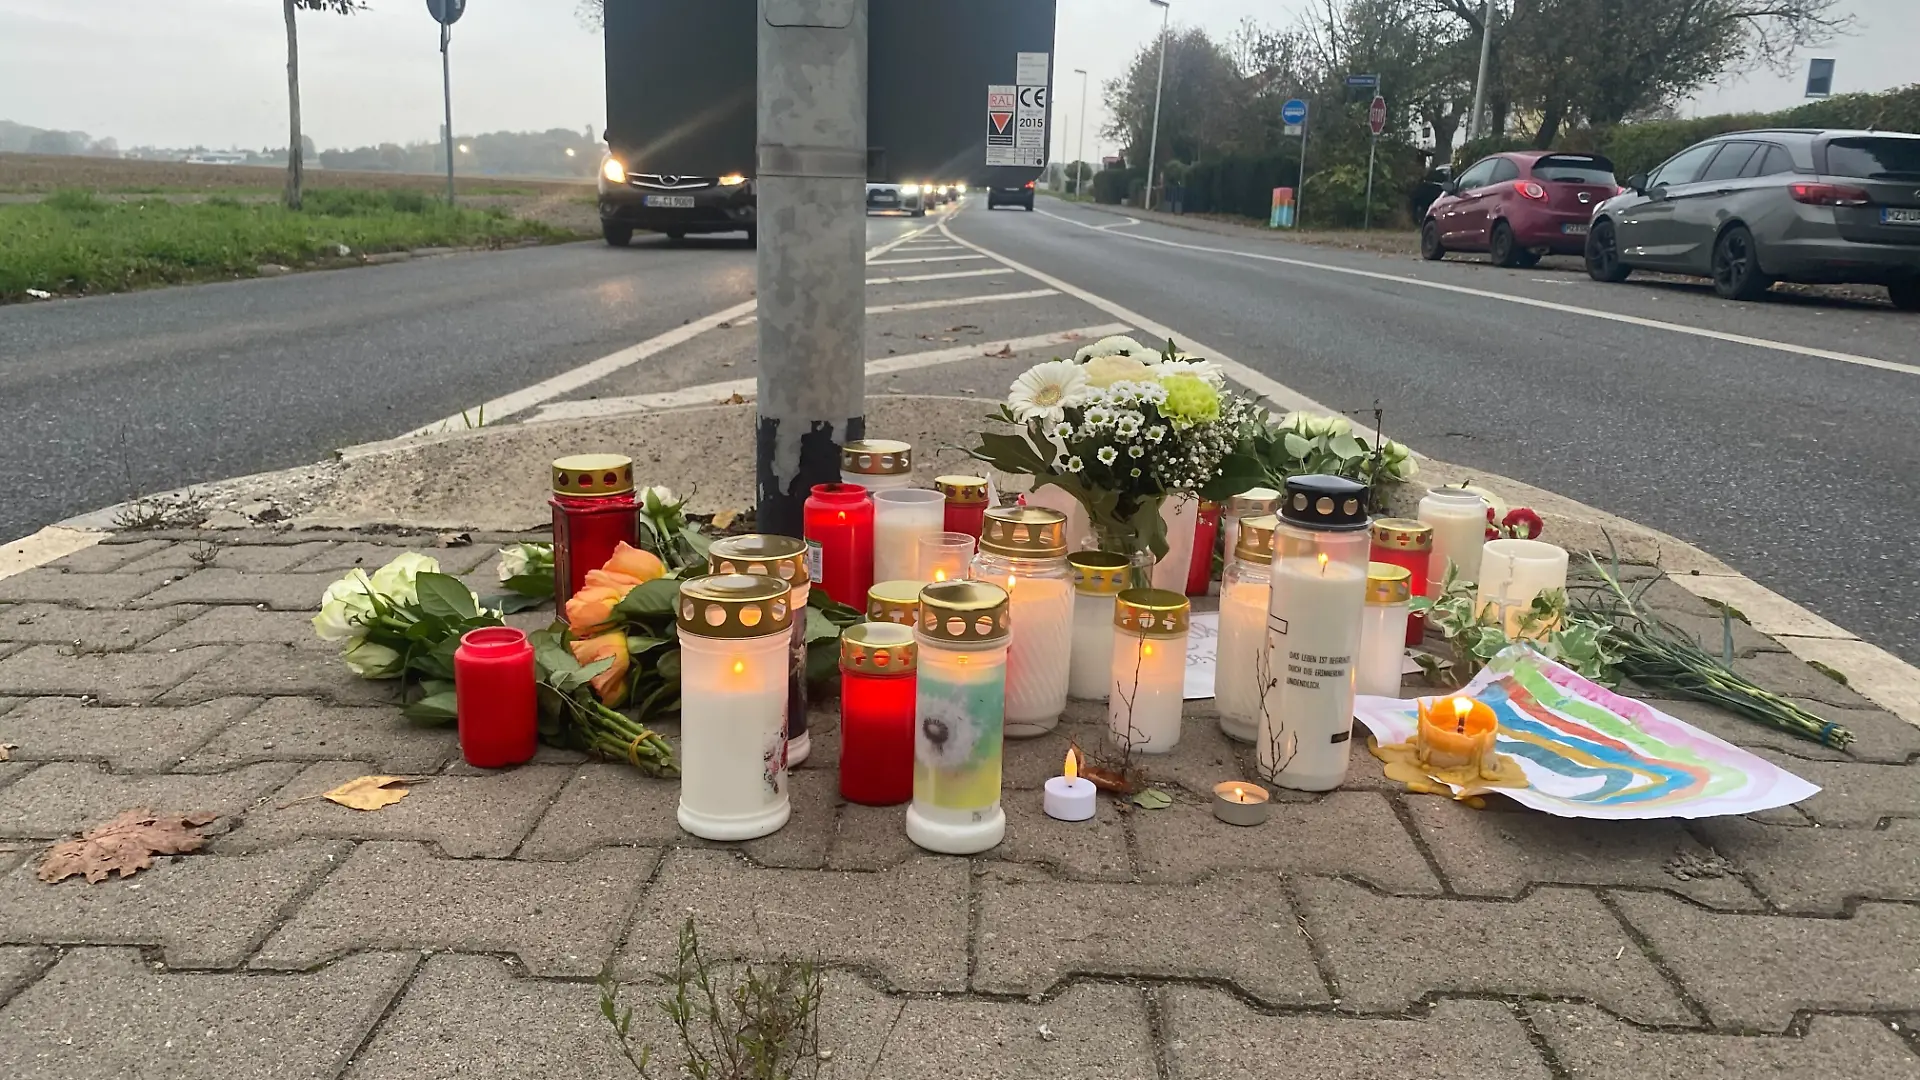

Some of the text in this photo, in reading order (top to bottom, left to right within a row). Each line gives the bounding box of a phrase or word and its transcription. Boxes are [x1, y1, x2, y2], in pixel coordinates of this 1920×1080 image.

[991, 95, 1012, 106] RAL
[1371, 107, 1385, 122] STOP
[1019, 118, 1043, 128] 2015
[1289, 651, 1300, 660] DAS
[1301, 654, 1317, 663] LEBEN
[1319, 656, 1328, 664] IST
